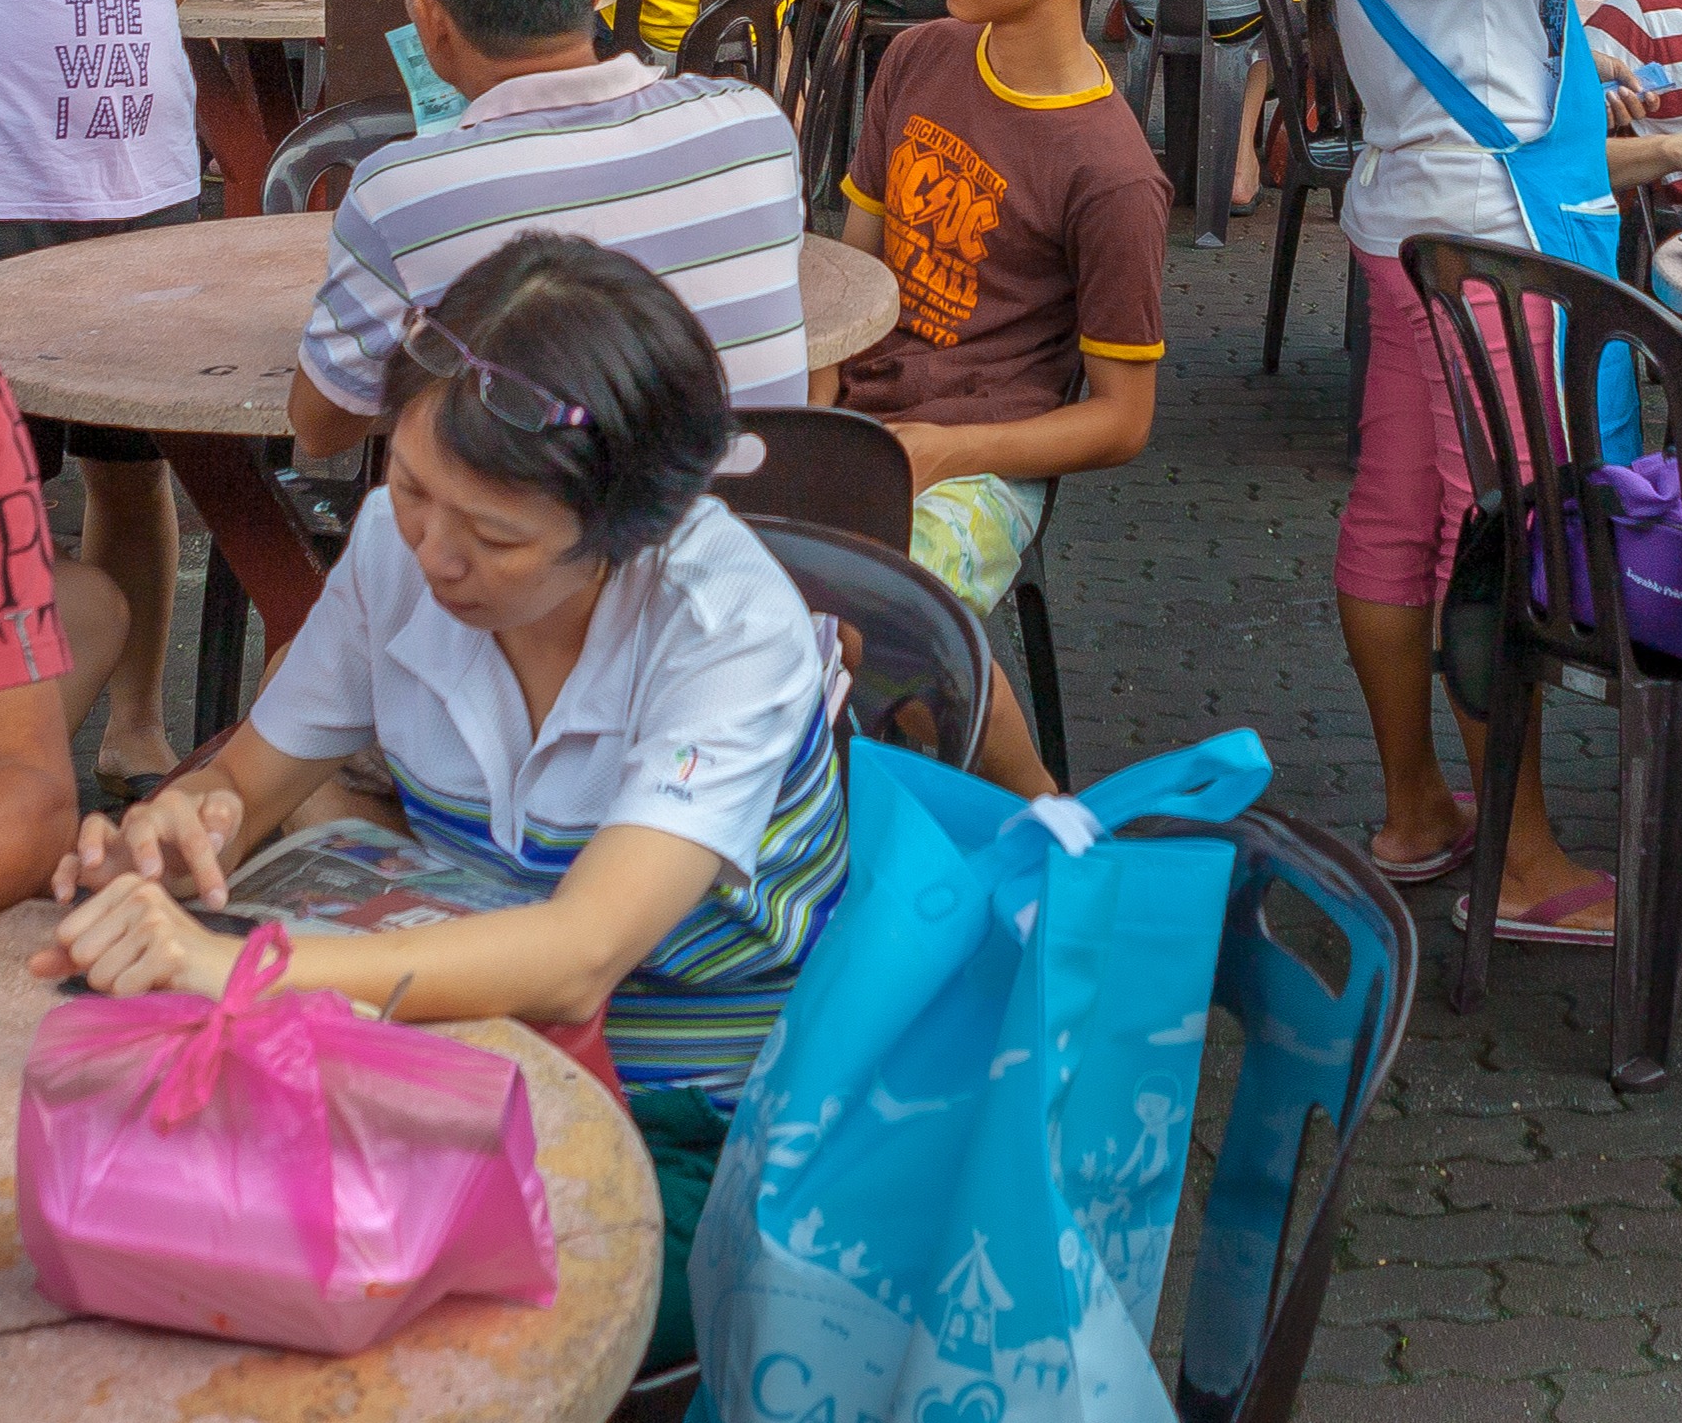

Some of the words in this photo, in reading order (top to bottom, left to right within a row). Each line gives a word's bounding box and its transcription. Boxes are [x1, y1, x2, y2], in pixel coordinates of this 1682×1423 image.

[55, 42, 151, 89] WAY
[55, 95, 69, 141] I
[85, 93, 155, 141] AM
